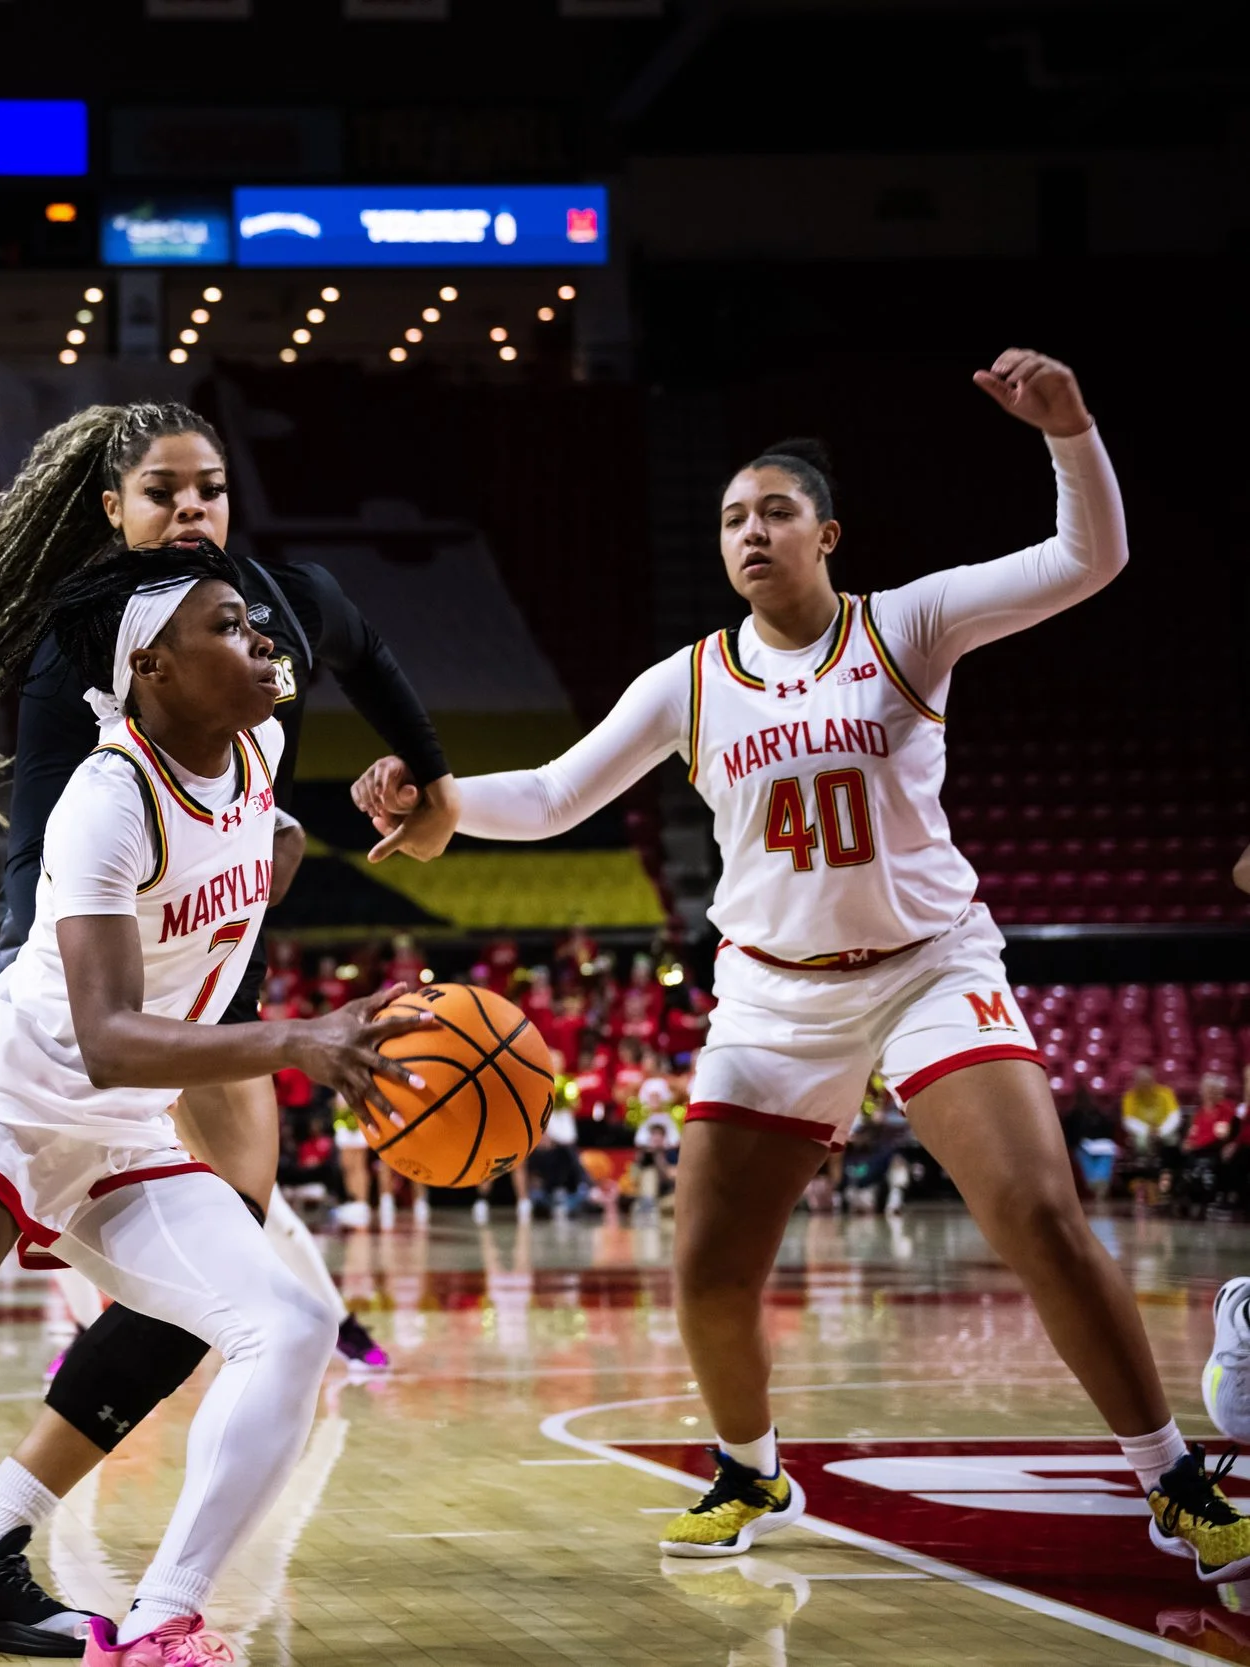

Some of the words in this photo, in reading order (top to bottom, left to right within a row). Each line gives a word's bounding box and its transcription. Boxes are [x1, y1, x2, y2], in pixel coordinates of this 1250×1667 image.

[723, 718, 889, 788] MARYLAND
[765, 768, 875, 872] 40
[158, 860, 273, 944] MARYLAN
[184, 918, 250, 1022] 7
[847, 948, 869, 964] M
[962, 991, 1015, 1027] M
